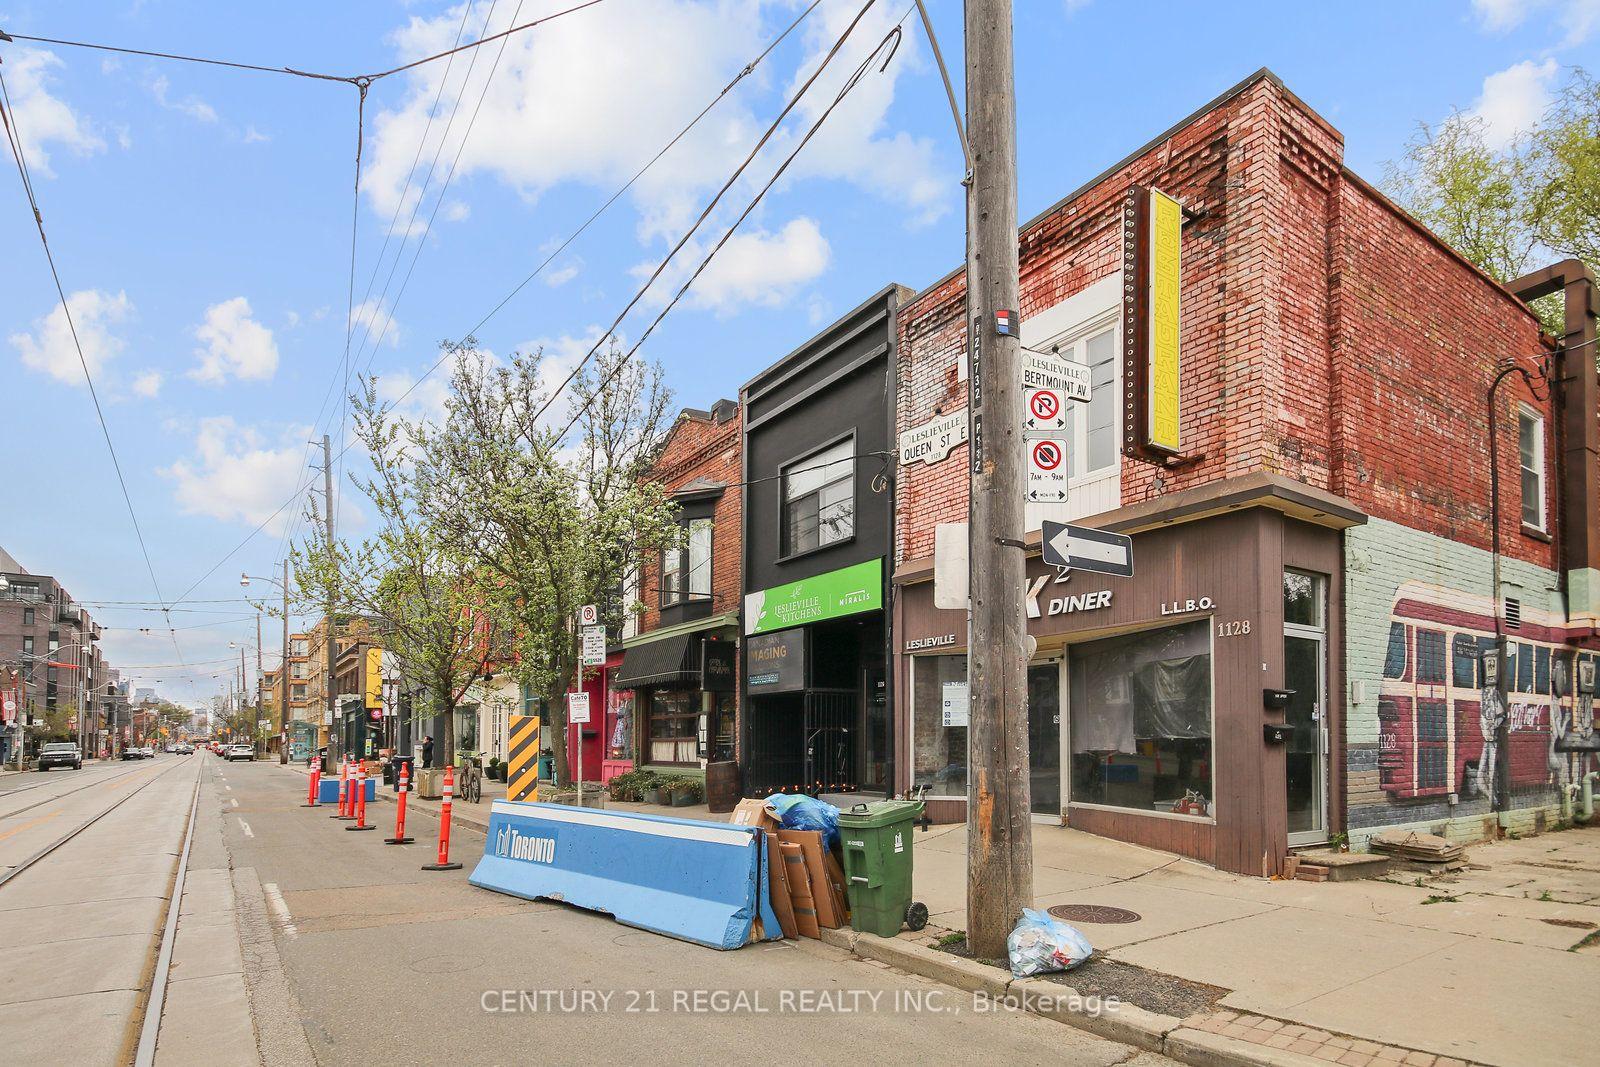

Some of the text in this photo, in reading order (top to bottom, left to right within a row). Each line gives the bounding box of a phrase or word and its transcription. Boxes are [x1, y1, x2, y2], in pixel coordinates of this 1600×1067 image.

[1154, 201, 1177, 441] RESTAURANT
[1032, 358, 1080, 380] LESLIEVILLE
[1024, 370, 1087, 396] BERTMOUNT AV
[912, 417, 960, 443] LESLIEVILLE
[904, 440, 932, 461] QUEEN
[1030, 473, 1042, 481] 7AM
[1051, 473, 1064, 481] 9AM
[774, 597, 819, 617] LESLIEVILLE
[1048, 590, 1113, 616] DINER
[1161, 596, 1216, 616] L.L.B.O.
[782, 606, 822, 624] KITCHENS
[1217, 620, 1251, 637] 1128
[906, 633, 955, 650] LESLIEVILLE
[1379, 733, 1397, 749] 1128
